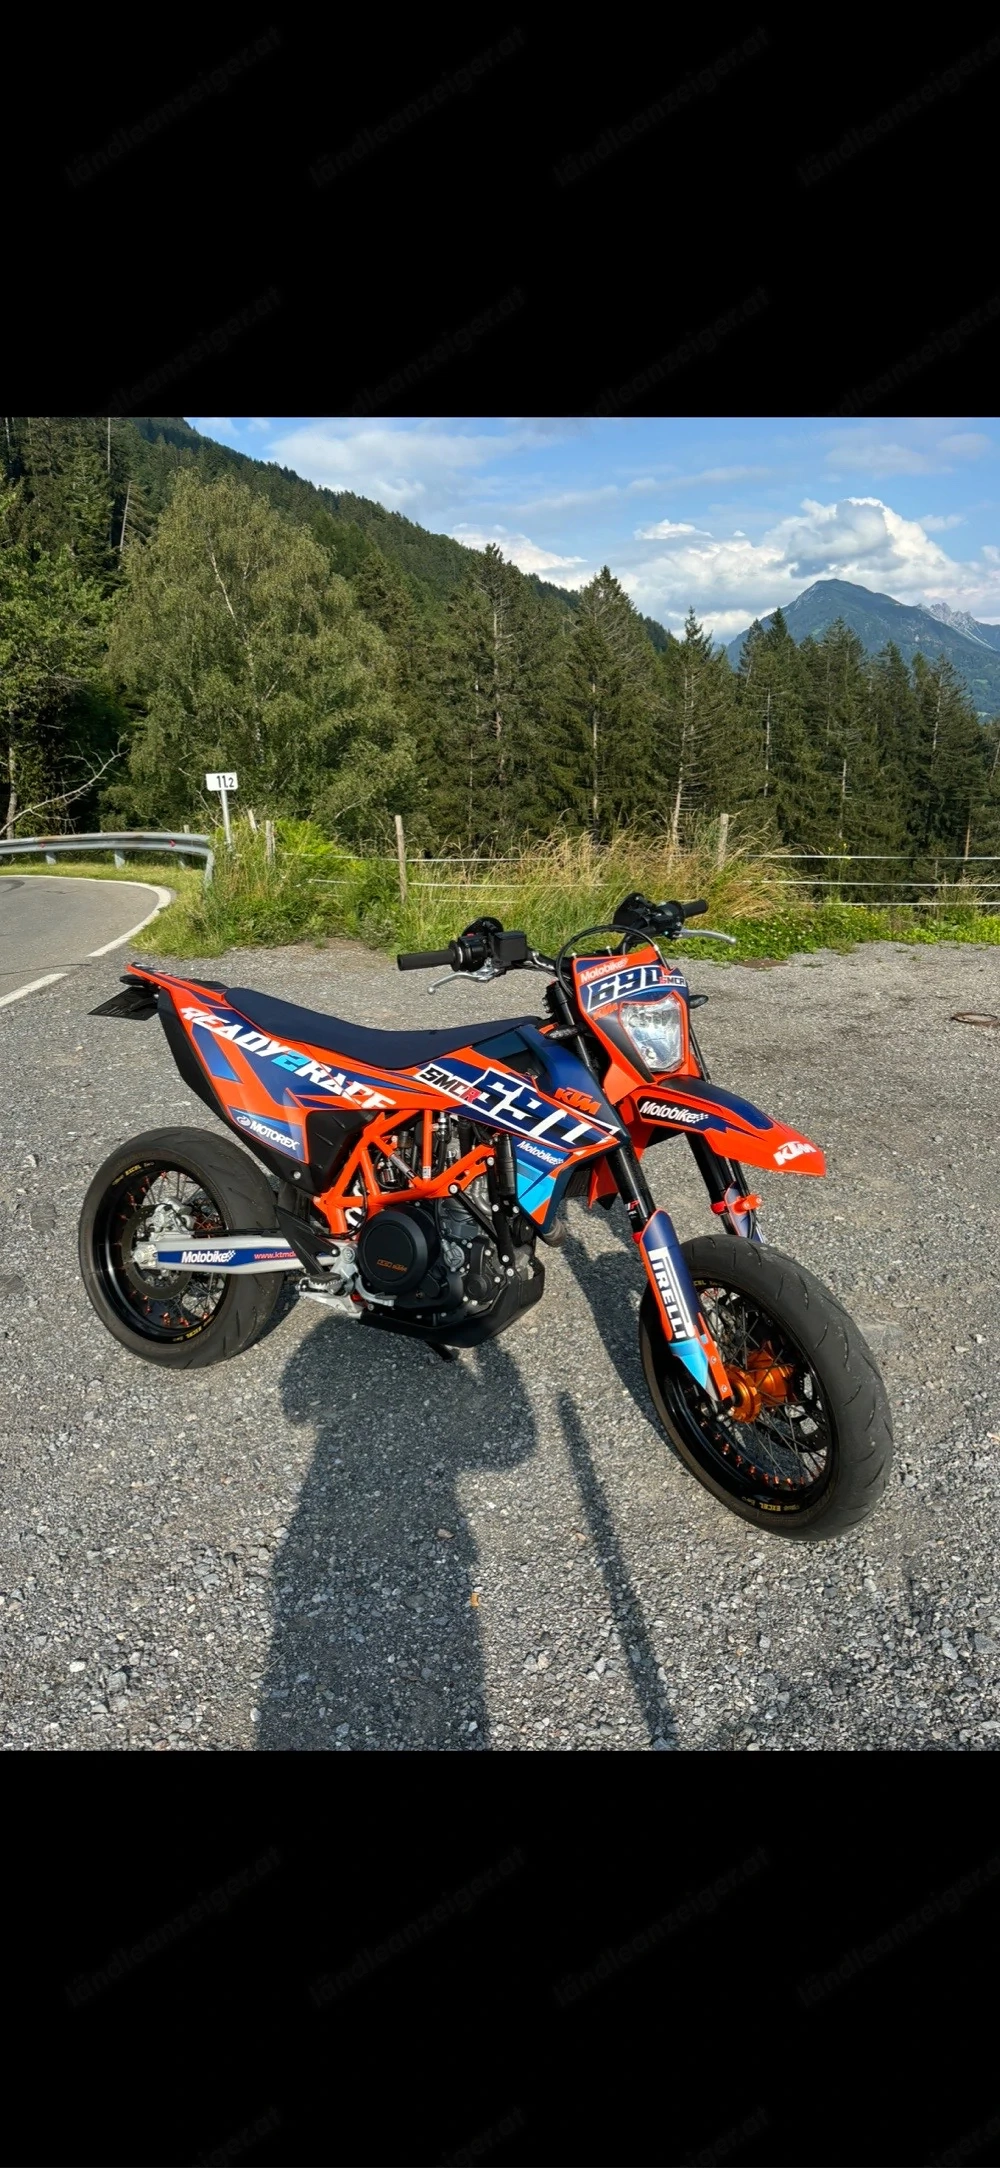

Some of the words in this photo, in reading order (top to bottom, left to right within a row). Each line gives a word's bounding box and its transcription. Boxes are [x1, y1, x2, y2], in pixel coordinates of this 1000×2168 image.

[580, 961, 623, 984] Motobike
[588, 966, 663, 1011] 690
[419, 1067, 481, 1104] SMCR
[554, 1087, 602, 1115] KTM
[640, 1101, 695, 1124] Motobike
[249, 1120, 300, 1150] MOTOREX
[517, 1141, 559, 1165] Motobike
[773, 1141, 816, 1166] KTM
[181, 1251, 228, 1264] Motobike
[253, 1250, 297, 1260] www.ktmd
[648, 1247, 695, 1338] PIRELLI
